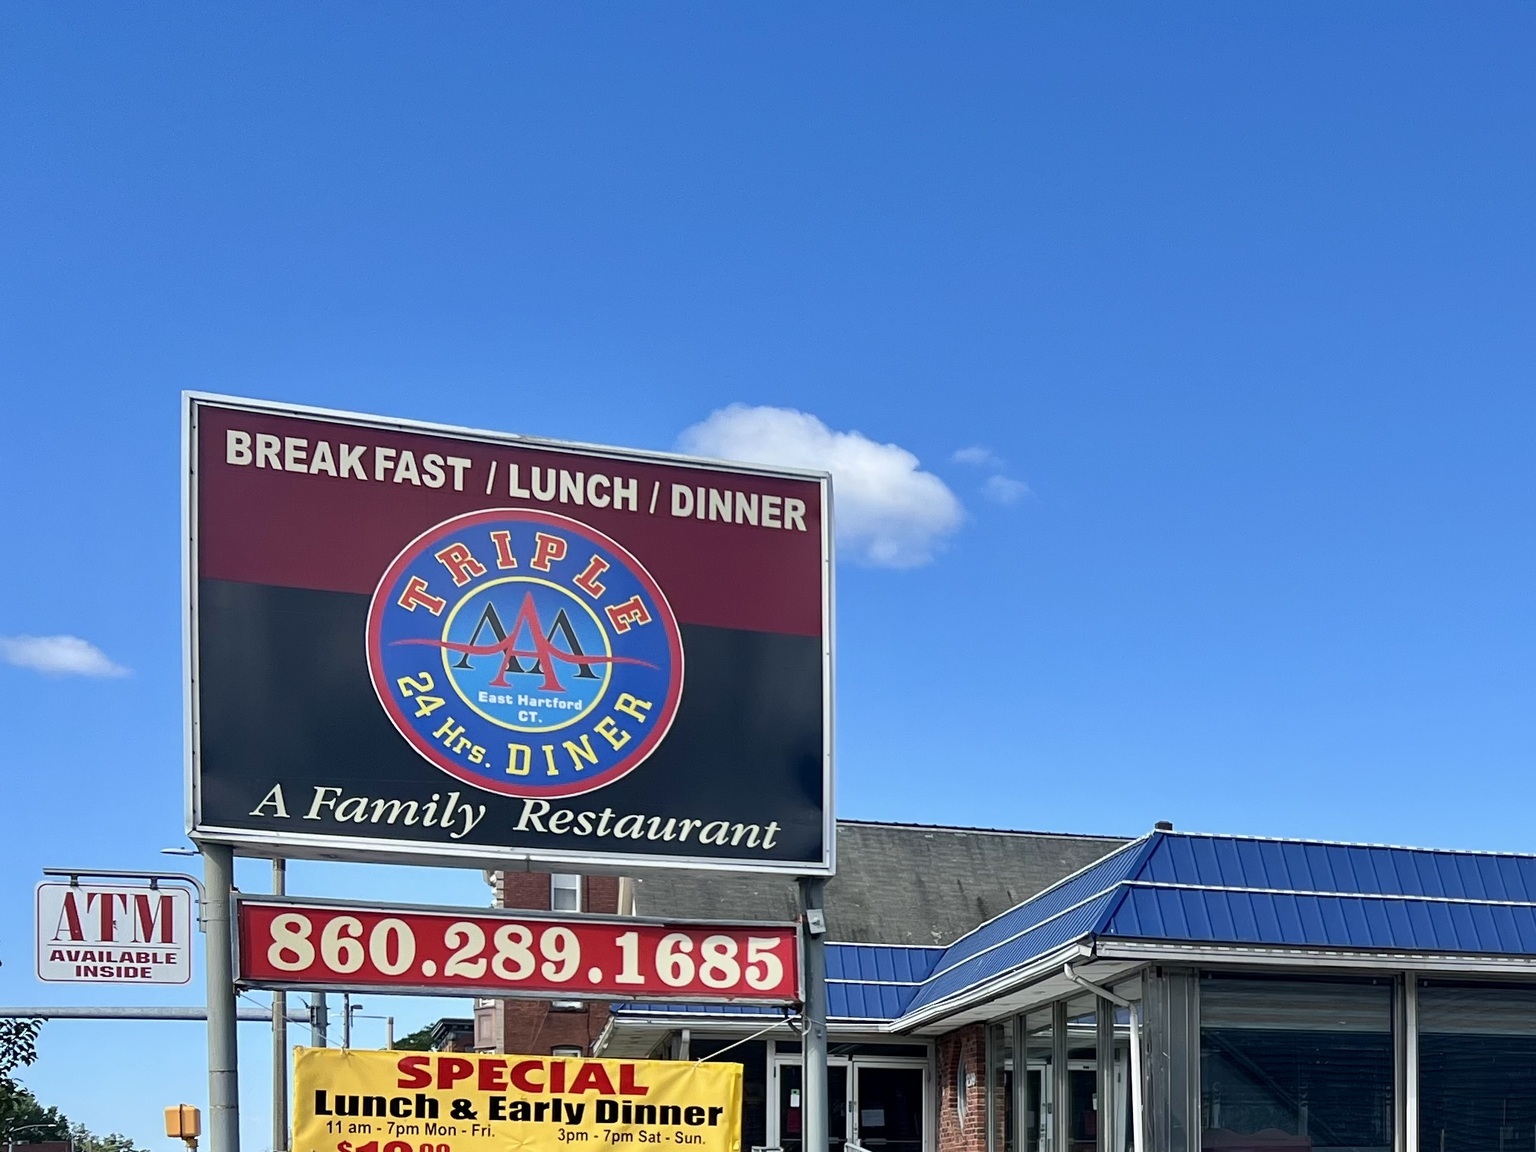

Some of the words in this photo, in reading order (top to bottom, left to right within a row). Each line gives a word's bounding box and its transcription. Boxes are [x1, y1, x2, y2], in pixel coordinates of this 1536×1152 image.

[486, 460, 498, 495] /
[509, 463, 638, 512] LUNCH
[648, 481, 660, 514] /
[671, 483, 808, 532] DINNER
[397, 530, 653, 635] TRIPLE
[478, 691, 513, 706] East
[517, 693, 583, 711] Hartford
[518, 710, 543, 724] CT.
[397, 671, 447, 719] 24
[432, 717, 491, 768] Hrs.
[505, 691, 654, 776] DINER
[249, 783, 291, 819] A
[303, 785, 487, 839] Family
[513, 798, 782, 850] Restaurant
[50, 891, 178, 944] ATM
[49, 949, 178, 965] AVAILABLE
[267, 913, 784, 991] 860.289.1685
[75, 965, 153, 979] INSIDE
[397, 1055, 650, 1096] SPECIAL
[314, 1089, 439, 1119] Lunch
[450, 1098, 478, 1121] &
[488, 1095, 586, 1126] Early
[595, 1098, 724, 1127] Dinner
[386, 1121, 420, 1138] 7pm
[424, 1122, 457, 1136] Mon
[471, 1123, 496, 1137] Fri.
[557, 1128, 589, 1144] 3pm
[603, 1129, 634, 1145] 7pm
[638, 1130, 662, 1143] Sat
[674, 1131, 706, 1145] Sun.
